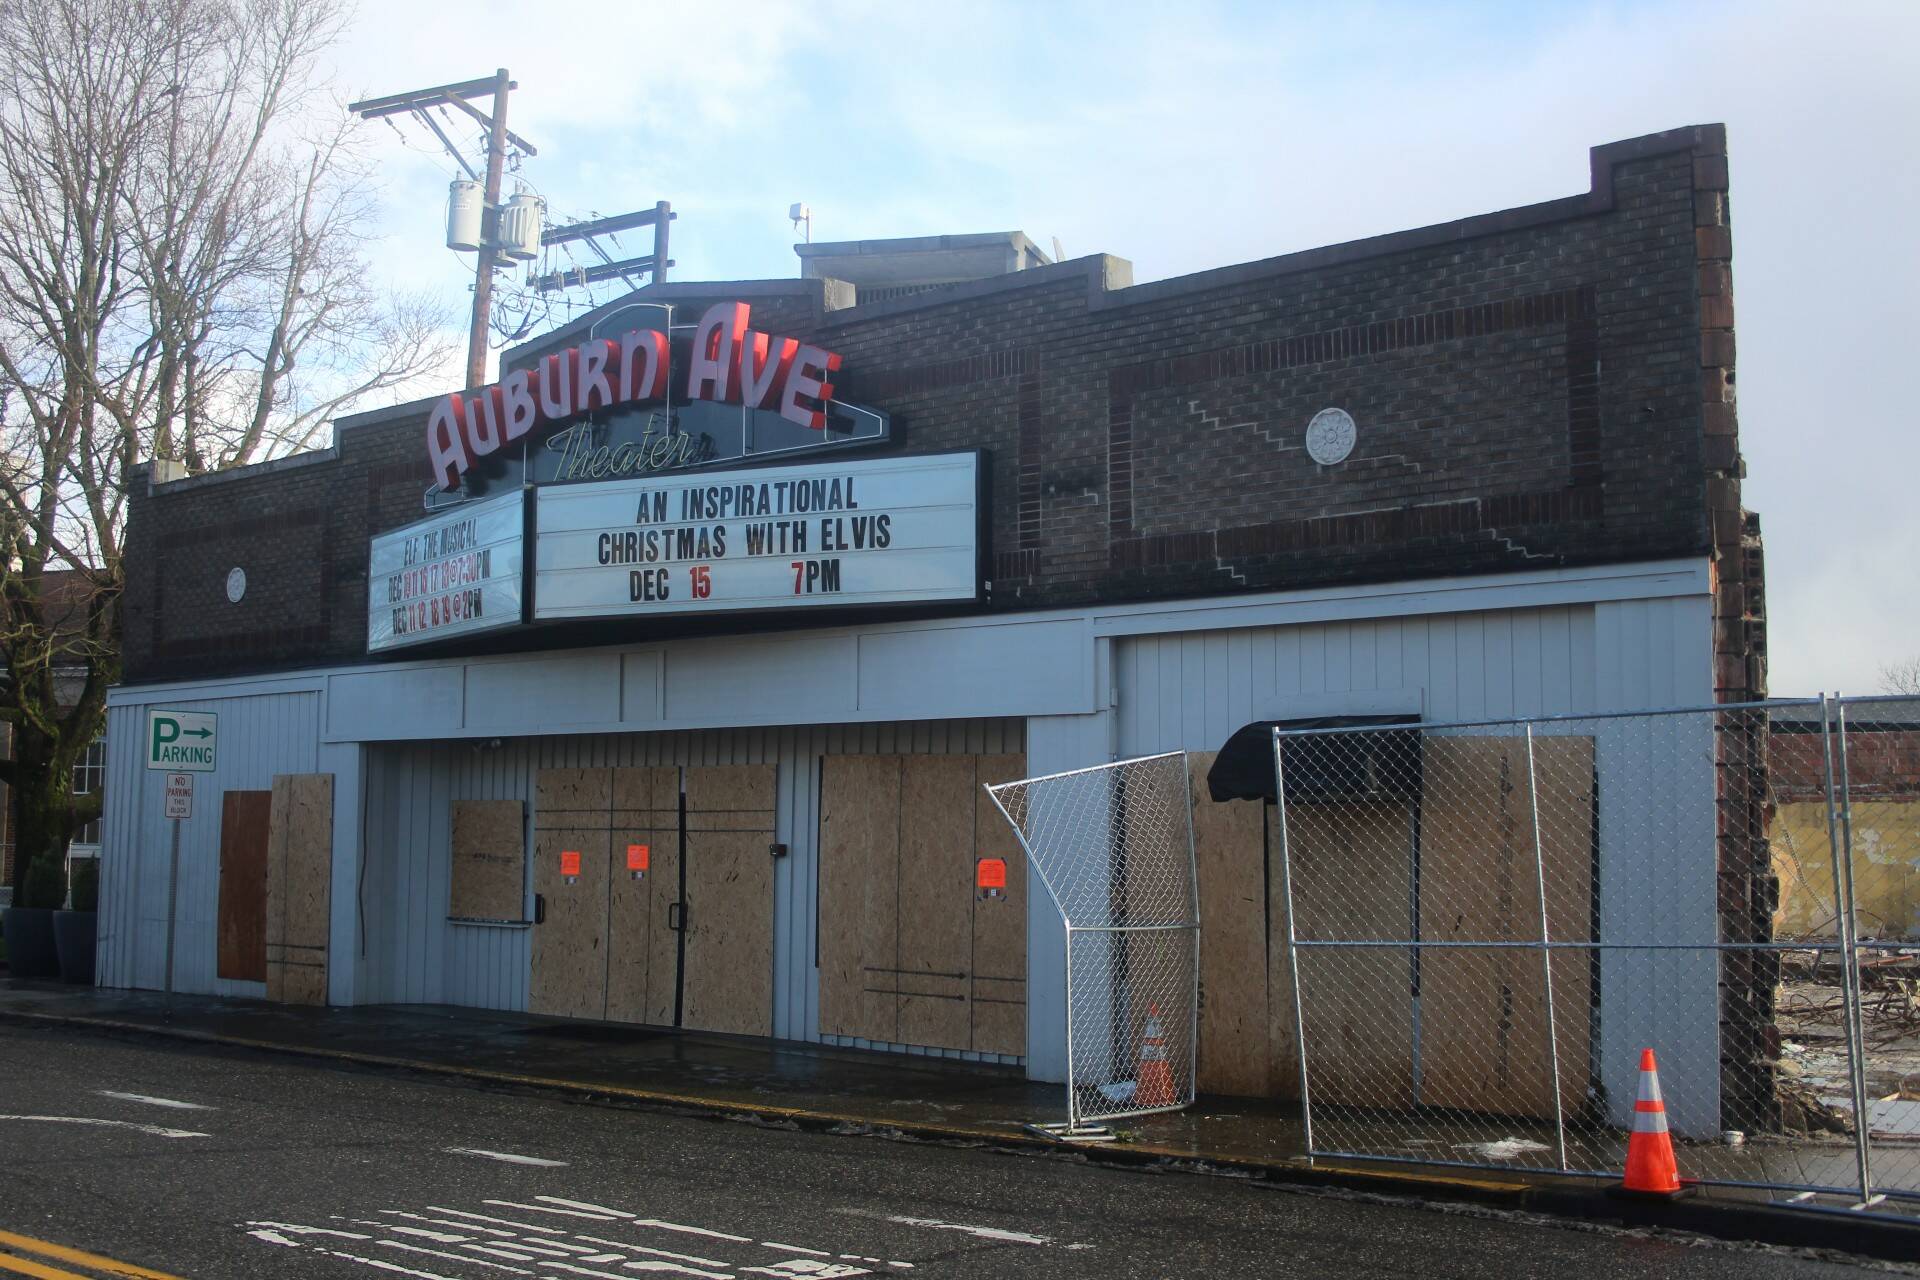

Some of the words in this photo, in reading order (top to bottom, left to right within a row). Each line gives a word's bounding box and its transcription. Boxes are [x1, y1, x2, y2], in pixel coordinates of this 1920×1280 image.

[427, 329, 670, 491] AUBURN
[688, 301, 842, 430] AVE
[546, 413, 695, 481] Theater
[636, 490, 667, 523] AN
[682, 476, 858, 521] INSPIRATIONAL
[404, 538, 418, 566] ELF
[424, 531, 438, 560] THE
[439, 518, 477, 556] MUSICAL
[598, 525, 726, 565] CHRISTMAS
[746, 520, 807, 556] WITH
[821, 514, 891, 550] ELVIS
[388, 575, 402, 603] DEC
[431, 565, 438, 592] 17
[629, 568, 669, 602] DEC
[689, 565, 711, 599] 15
[792, 559, 841, 595] 7PM
[392, 606, 407, 634] DEC
[408, 603, 415, 632] 11
[418, 601, 426, 630] 12
[431, 598, 439, 626] 18
[442, 595, 450, 625] 19
[463, 588, 482, 619] 2PM
[152, 717, 212, 763] PARKING
[167, 788, 192, 798] PARKING
[174, 776, 186, 786] NO
